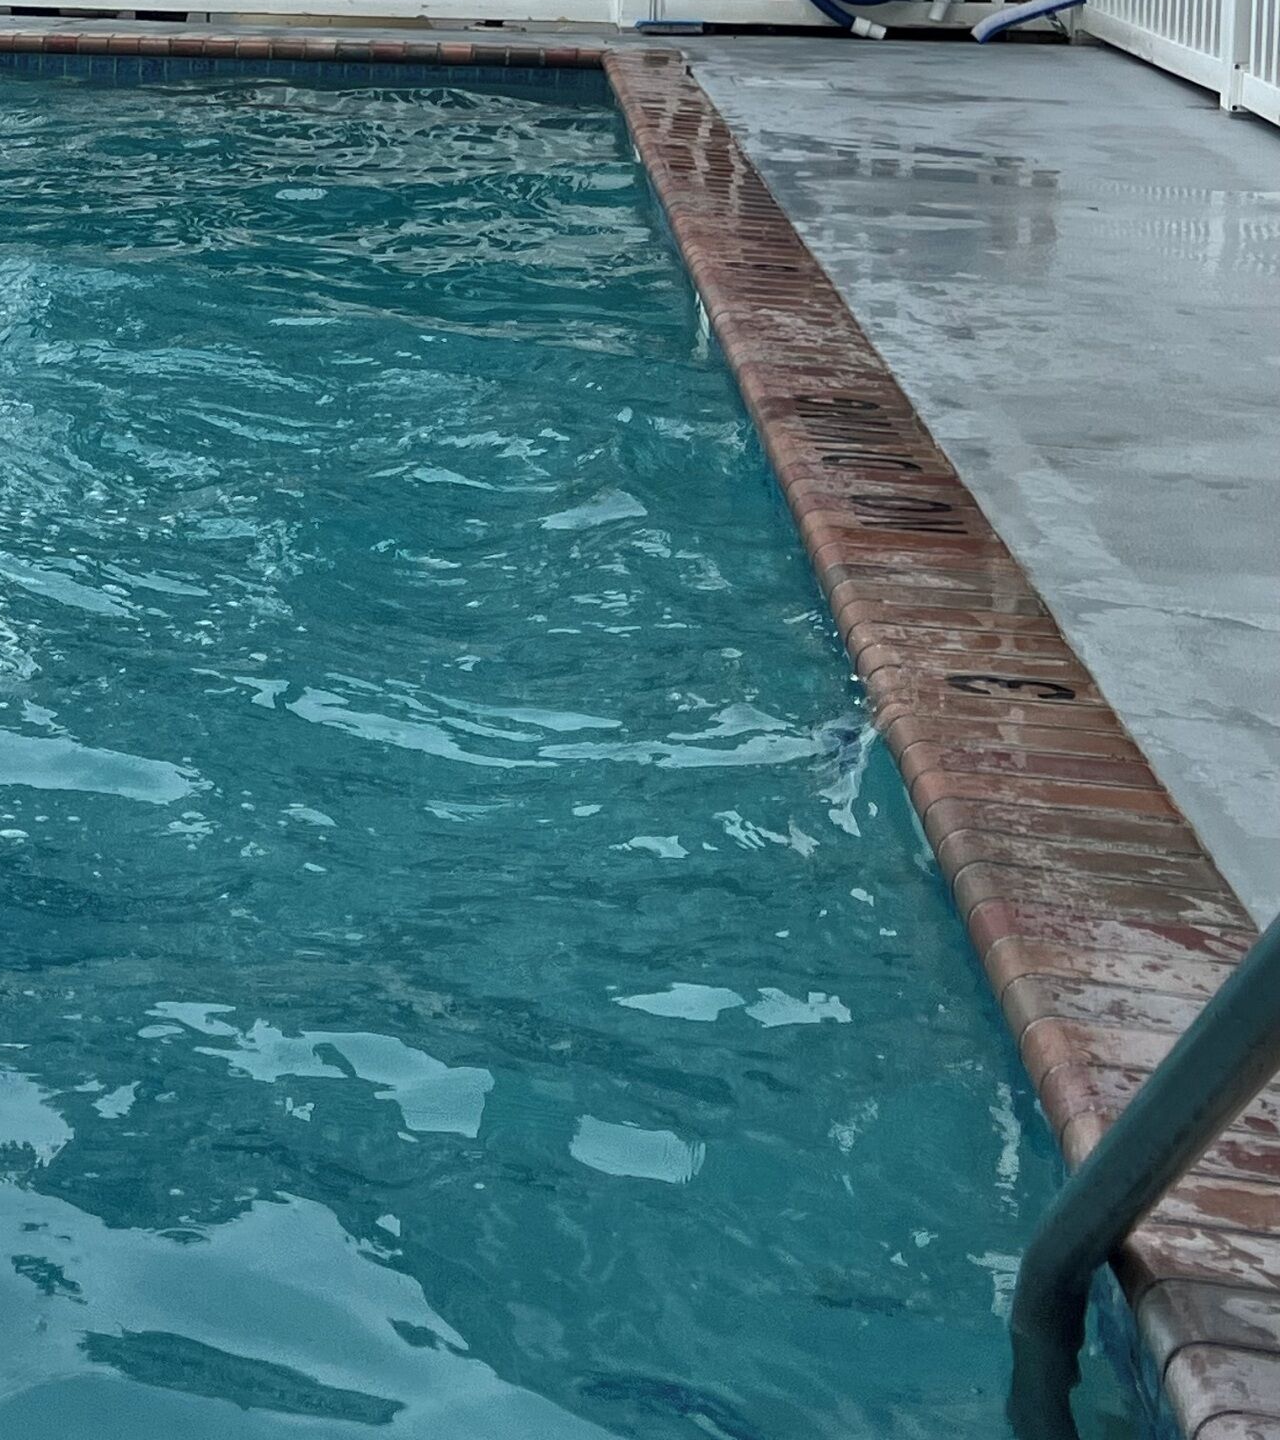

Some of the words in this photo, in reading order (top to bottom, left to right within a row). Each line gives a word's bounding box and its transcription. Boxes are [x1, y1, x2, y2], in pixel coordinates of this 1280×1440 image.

[793, 394, 923, 471] DIVING
[849, 494, 968, 535] NO
[944, 674, 1076, 700] 3
